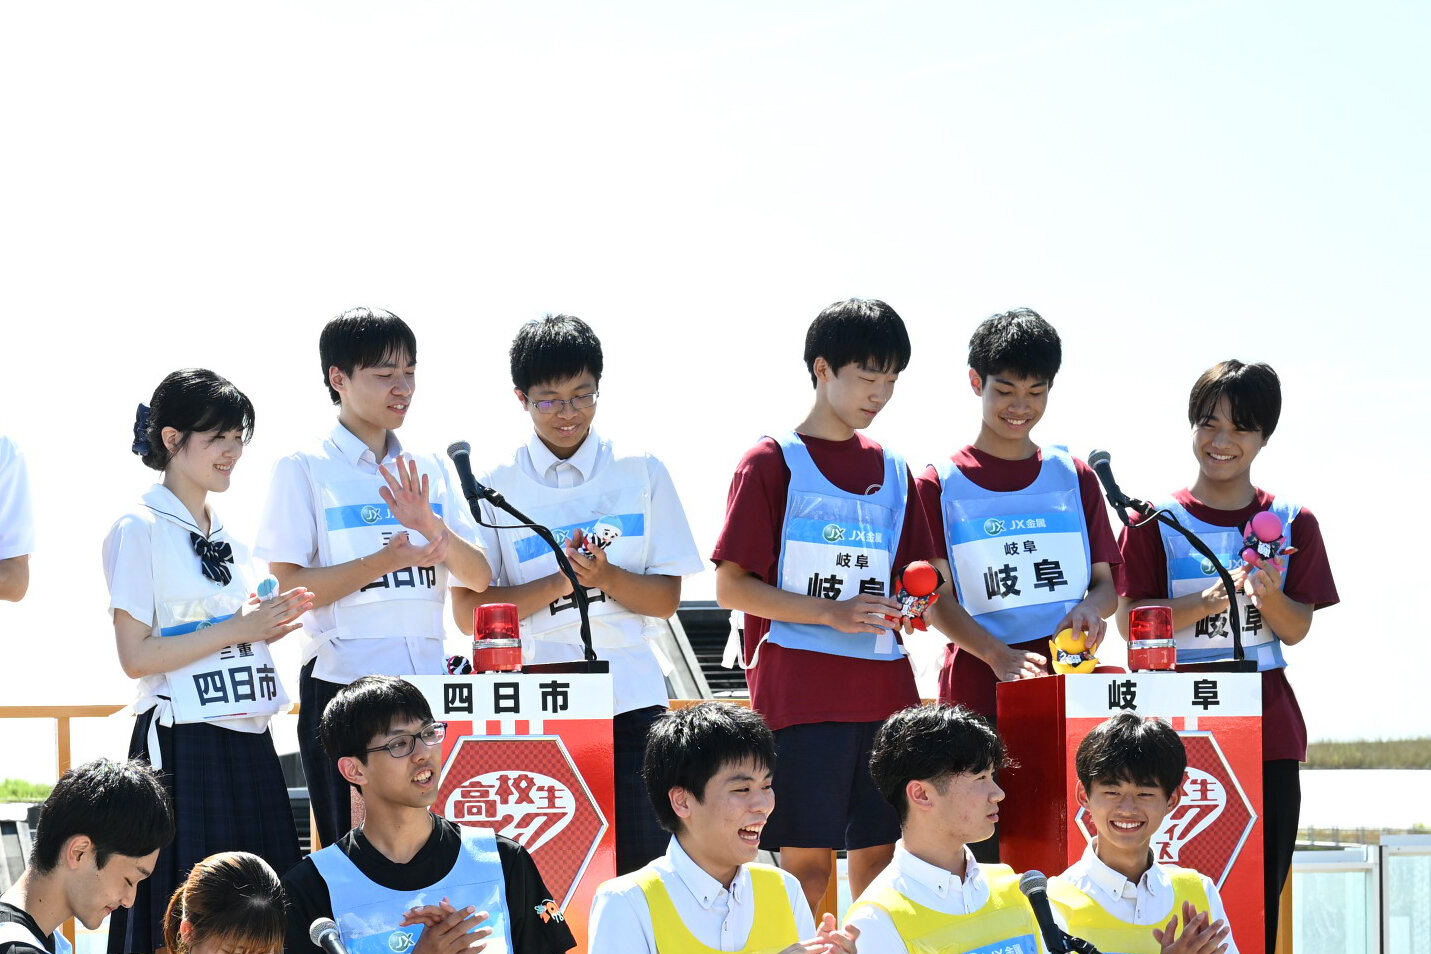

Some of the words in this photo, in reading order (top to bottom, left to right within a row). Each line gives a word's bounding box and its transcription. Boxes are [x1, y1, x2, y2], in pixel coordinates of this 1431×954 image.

[835, 552, 870, 570] 岐阜
[1004, 540, 1038, 557] 岐阜
[982, 558, 1068, 600] 岐阜
[220, 641, 255, 660] 三重
[192, 663, 278, 707] 四日市
[443, 680, 570, 715] 四日市
[1108, 678, 1220, 711] 岐阜
[453, 773, 567, 819] 高校生
